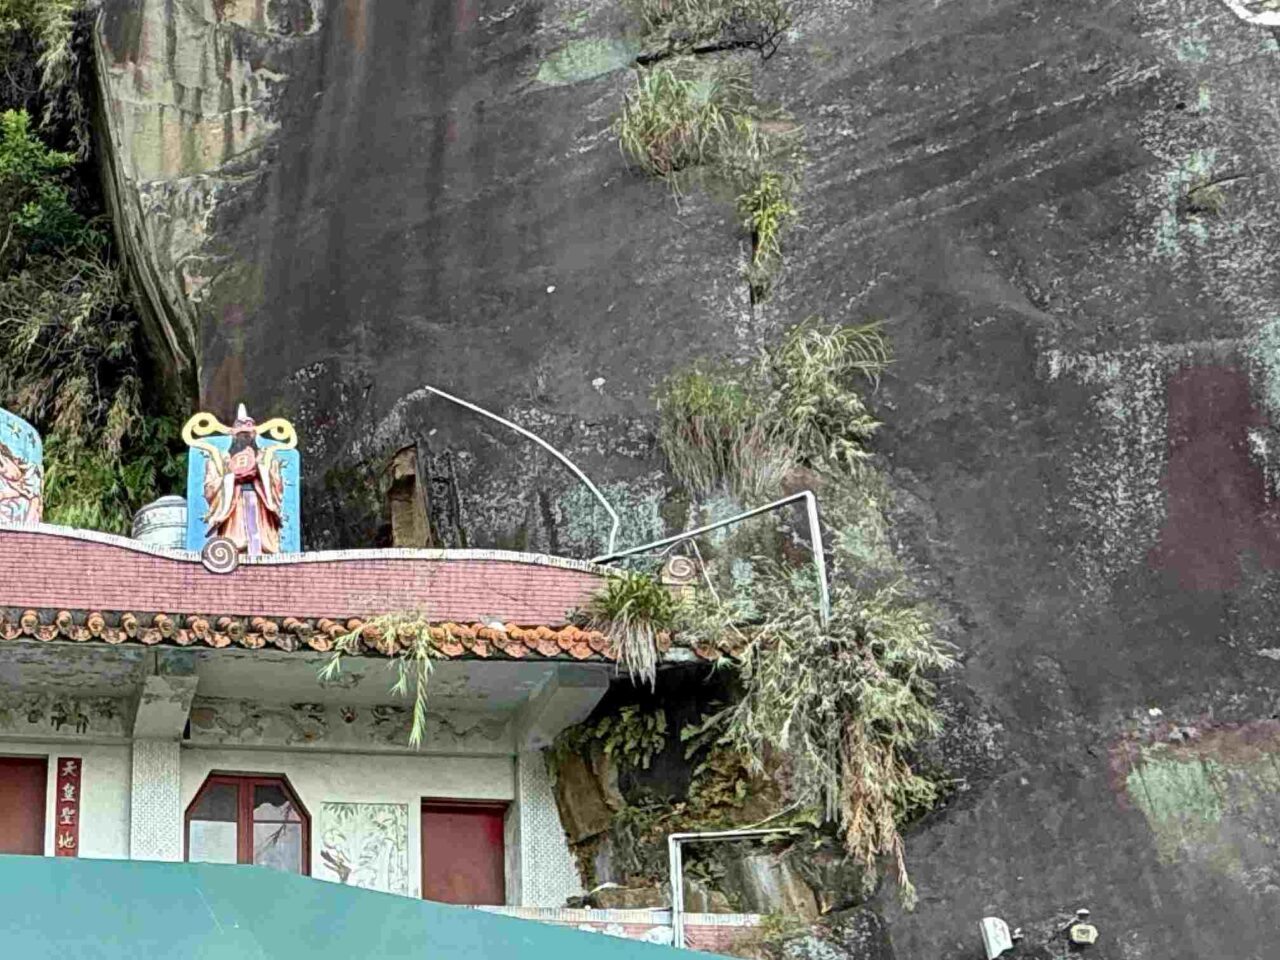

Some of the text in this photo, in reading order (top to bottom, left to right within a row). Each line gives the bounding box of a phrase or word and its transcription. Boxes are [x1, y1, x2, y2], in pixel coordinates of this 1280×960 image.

[236, 454, 249, 468] 日
[58, 760, 78, 850] 天皇聖地
